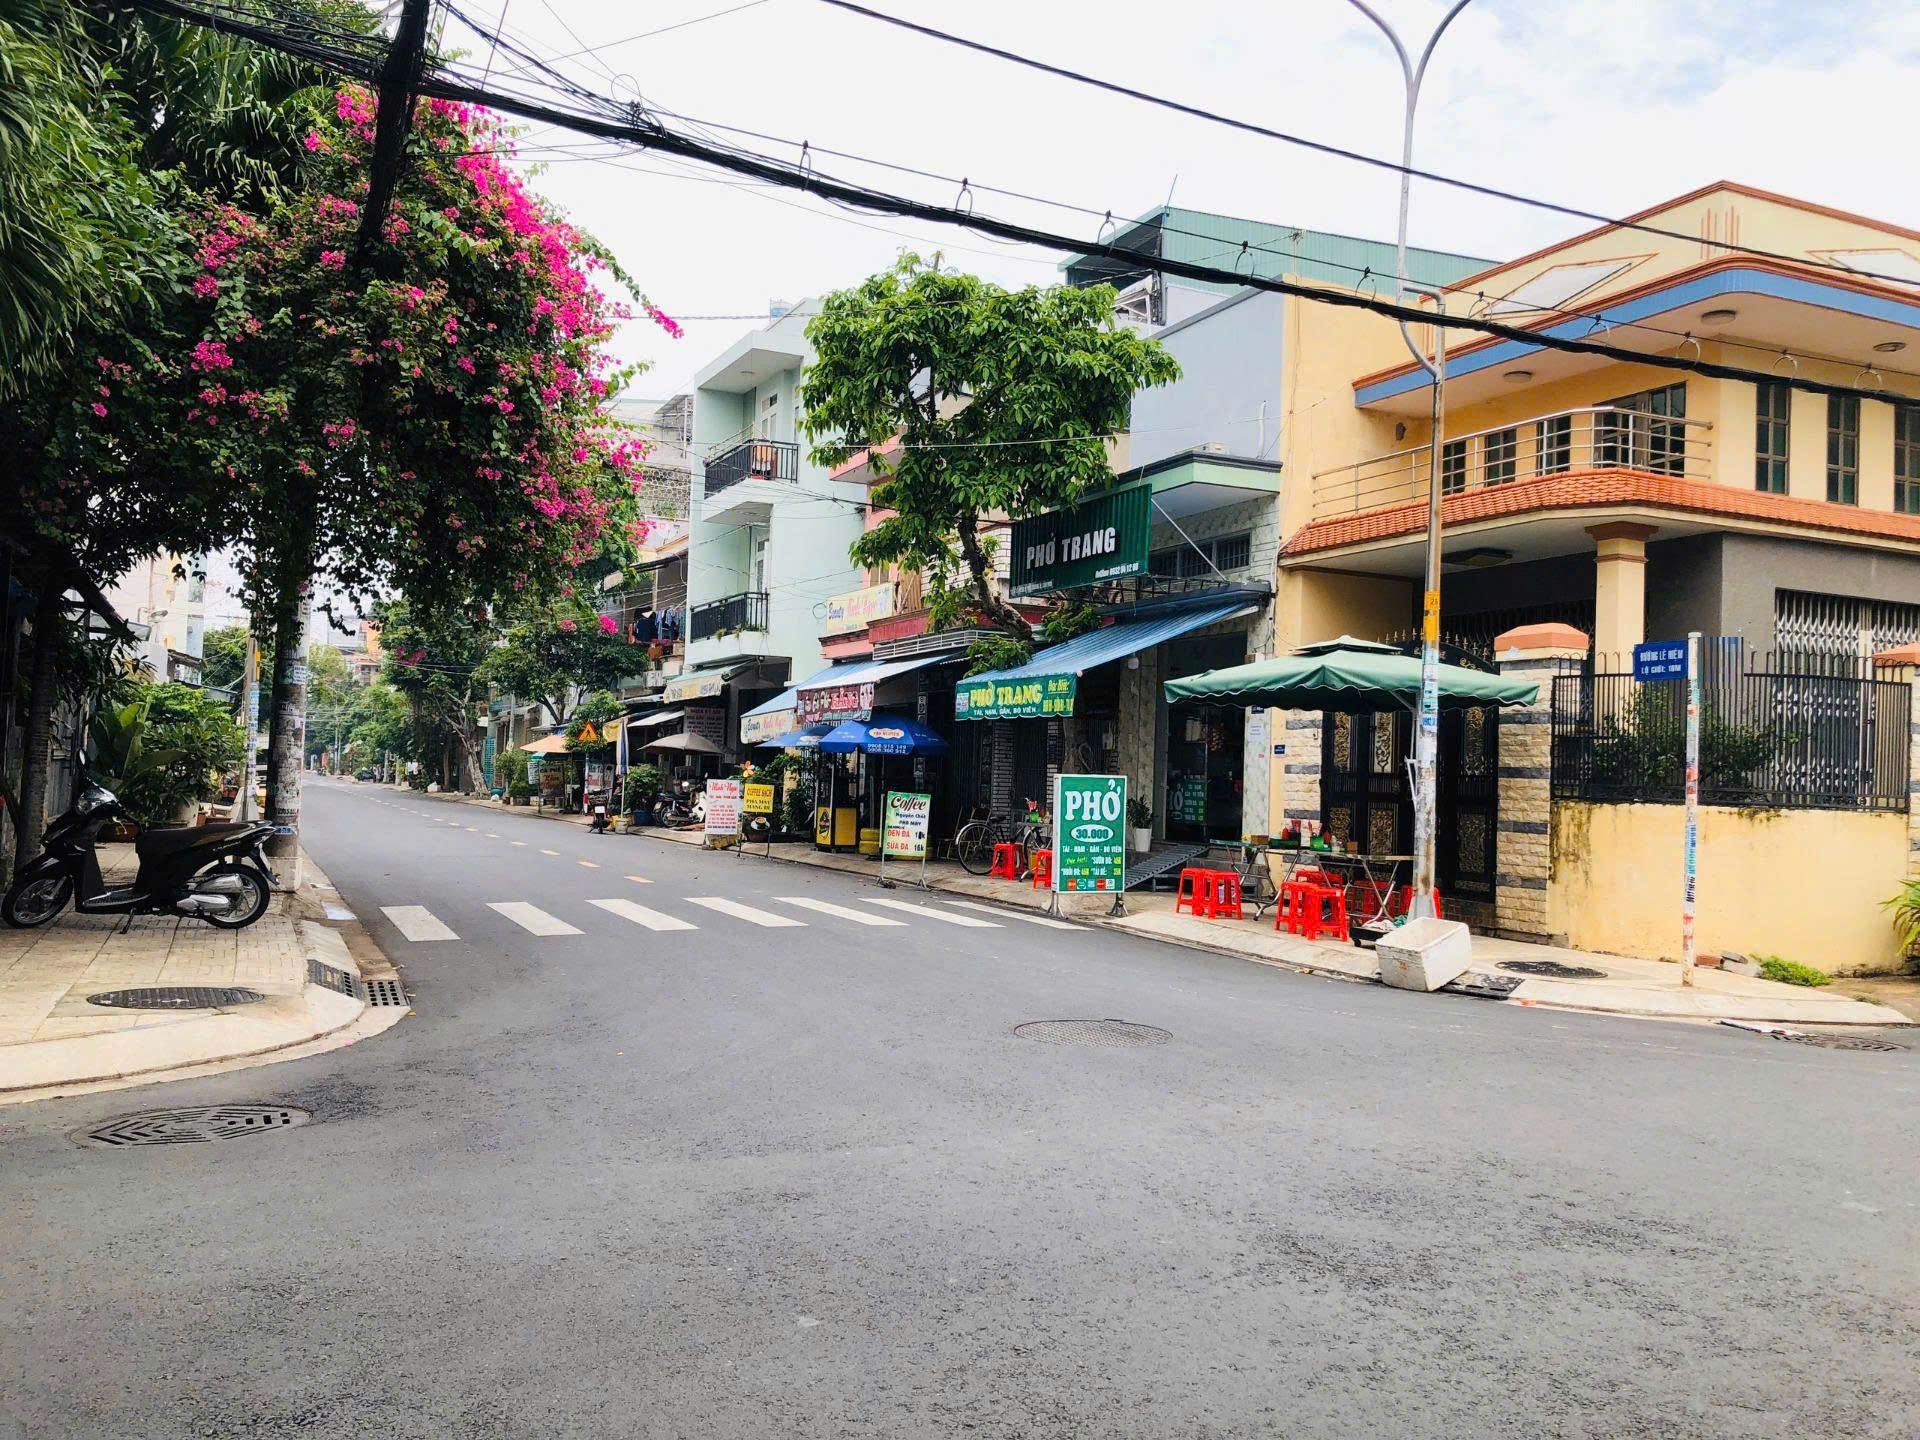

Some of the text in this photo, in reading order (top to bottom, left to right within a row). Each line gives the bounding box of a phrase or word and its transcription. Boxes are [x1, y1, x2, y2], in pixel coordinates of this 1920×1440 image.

[1026, 527, 1116, 570] PHỞ TRANG
[1659, 649, 1667, 660] LÊ
[970, 681, 995, 708] PHỞ
[997, 684, 1043, 706] TRANG
[891, 796, 926, 812] Coffee
[1065, 779, 1121, 821] PHỞ
[1076, 829, 1109, 839] 30.000
